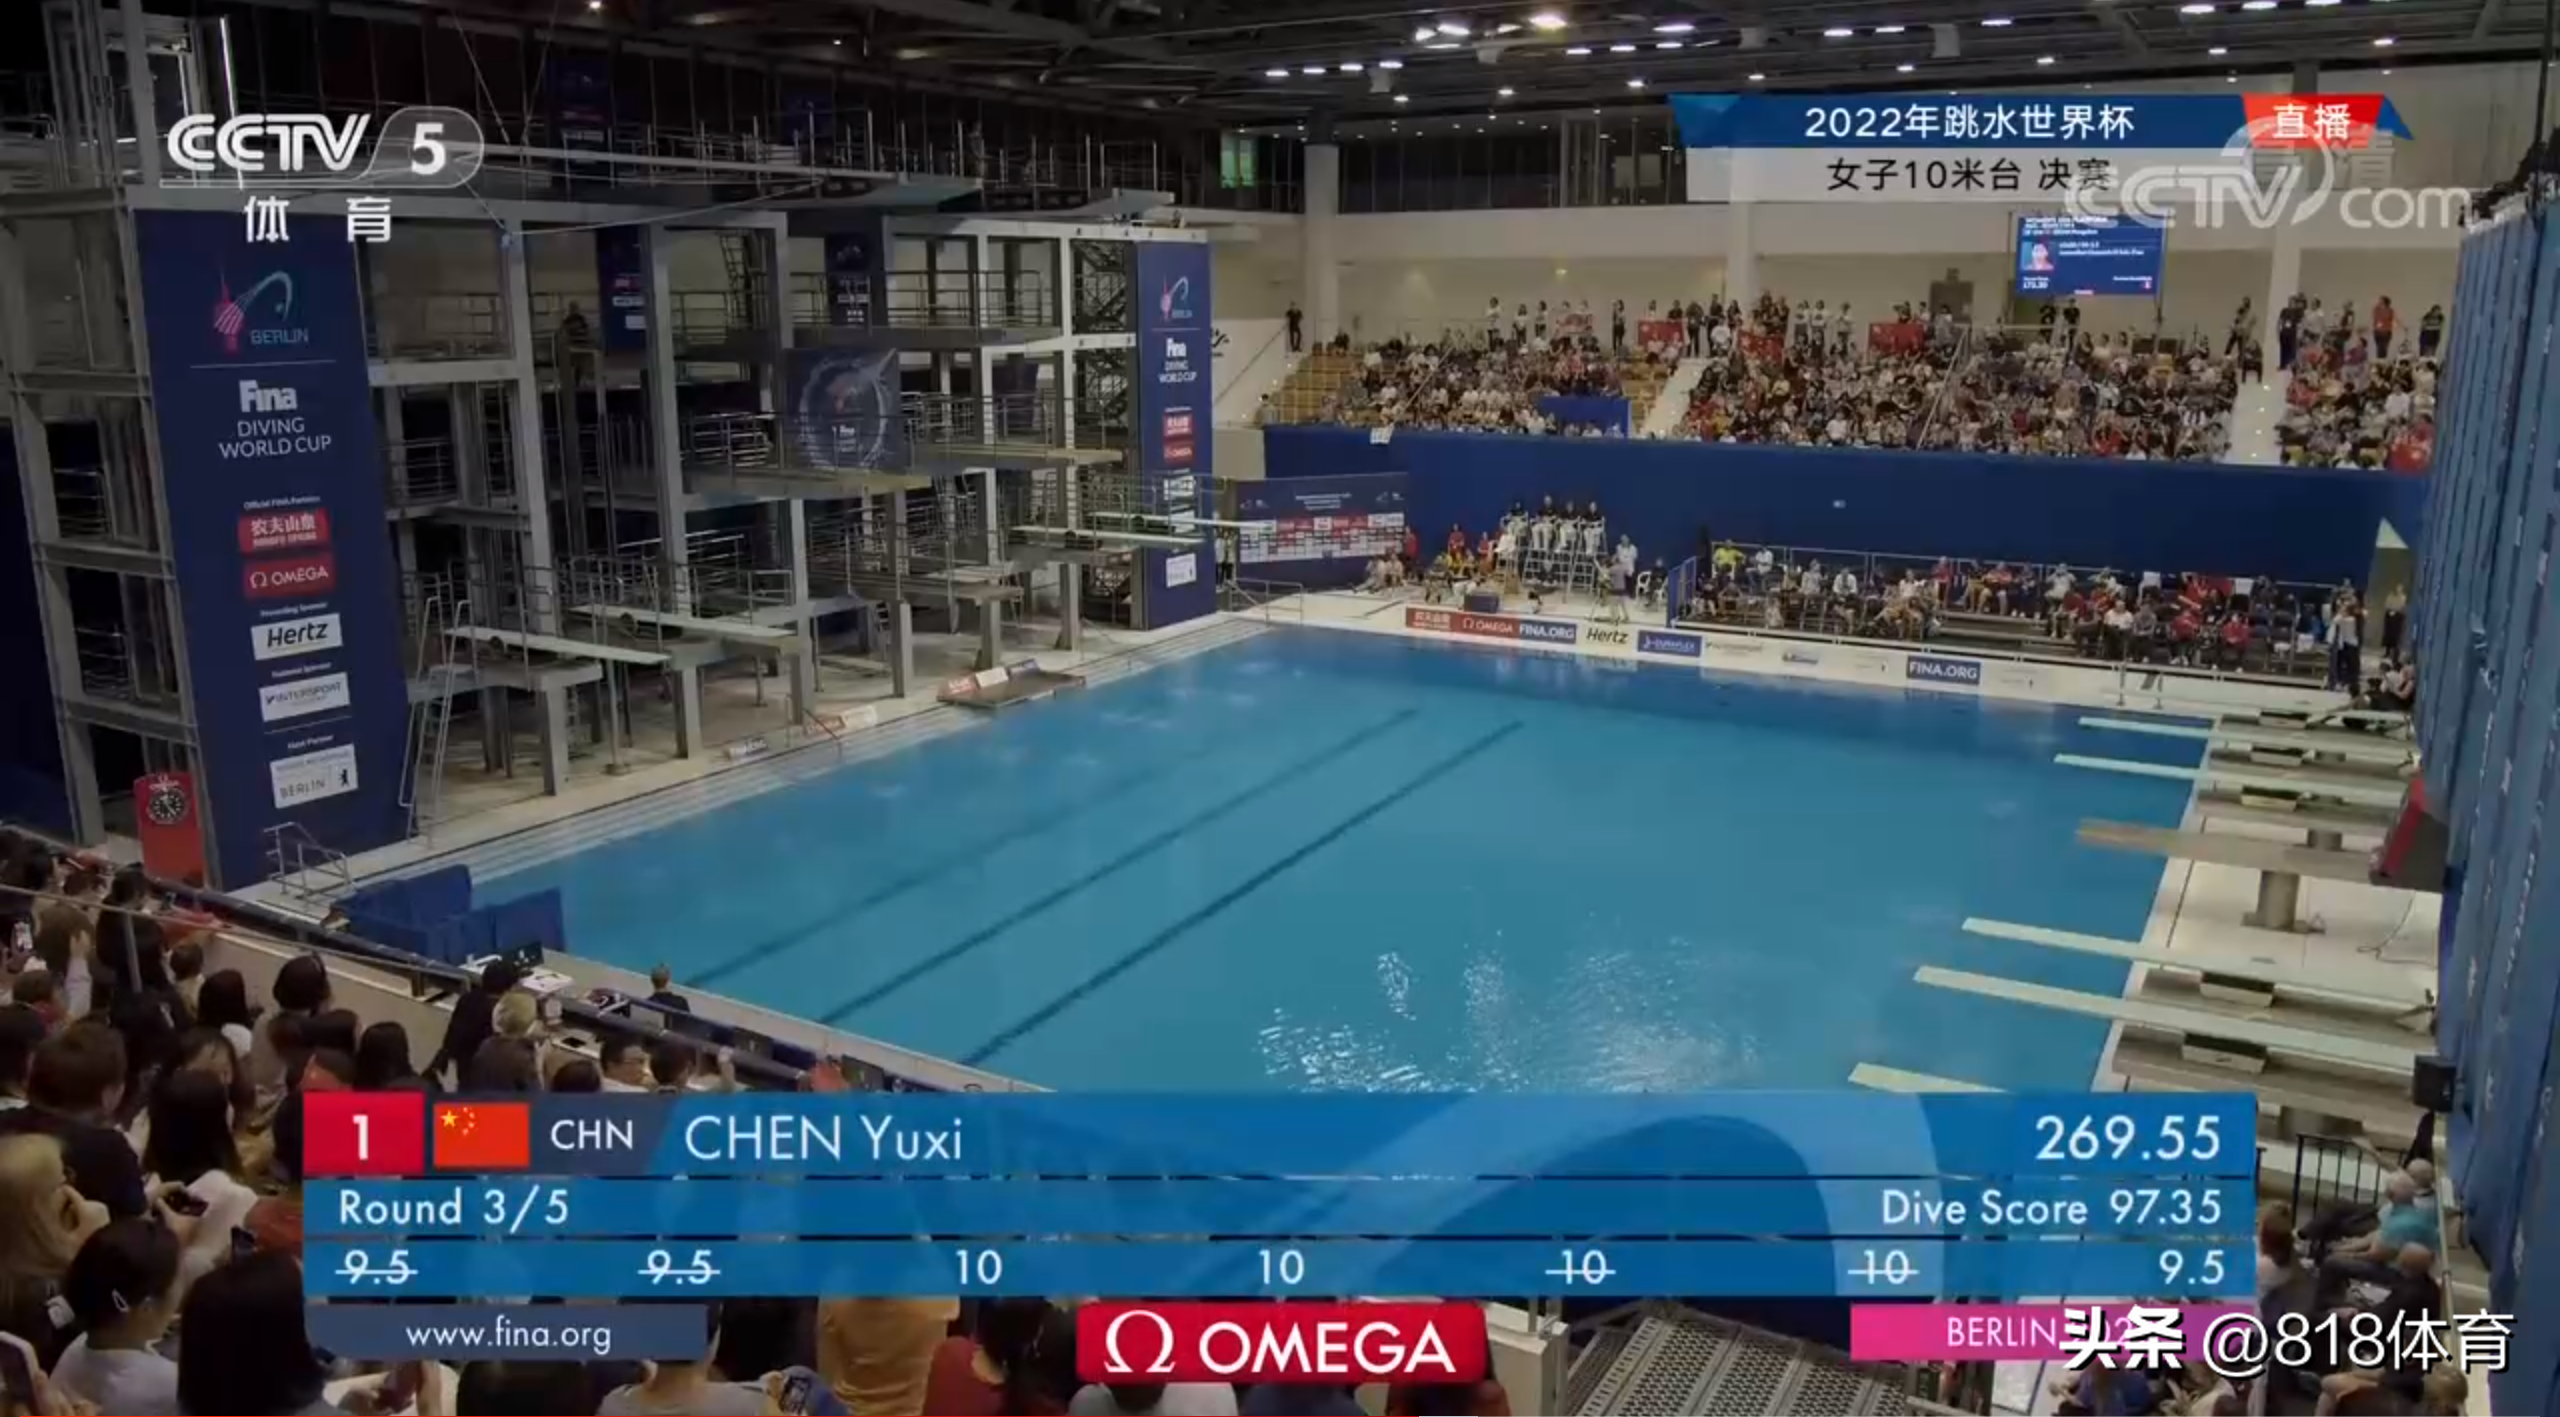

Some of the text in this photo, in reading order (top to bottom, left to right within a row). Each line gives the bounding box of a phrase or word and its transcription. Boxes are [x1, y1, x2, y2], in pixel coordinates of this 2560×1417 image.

[251, 328, 310, 345] BERLIN
[237, 417, 305, 438] DIVING
[218, 434, 333, 460] WORLD CUP
[271, 565, 329, 586] OMEGA
[267, 621, 329, 648] Hertz
[1519, 623, 1575, 640] FINA.ORG
[1586, 627, 1630, 644] Hertz
[1908, 661, 1978, 680] FINA.ORG
[279, 779, 325, 800] BERLIN
